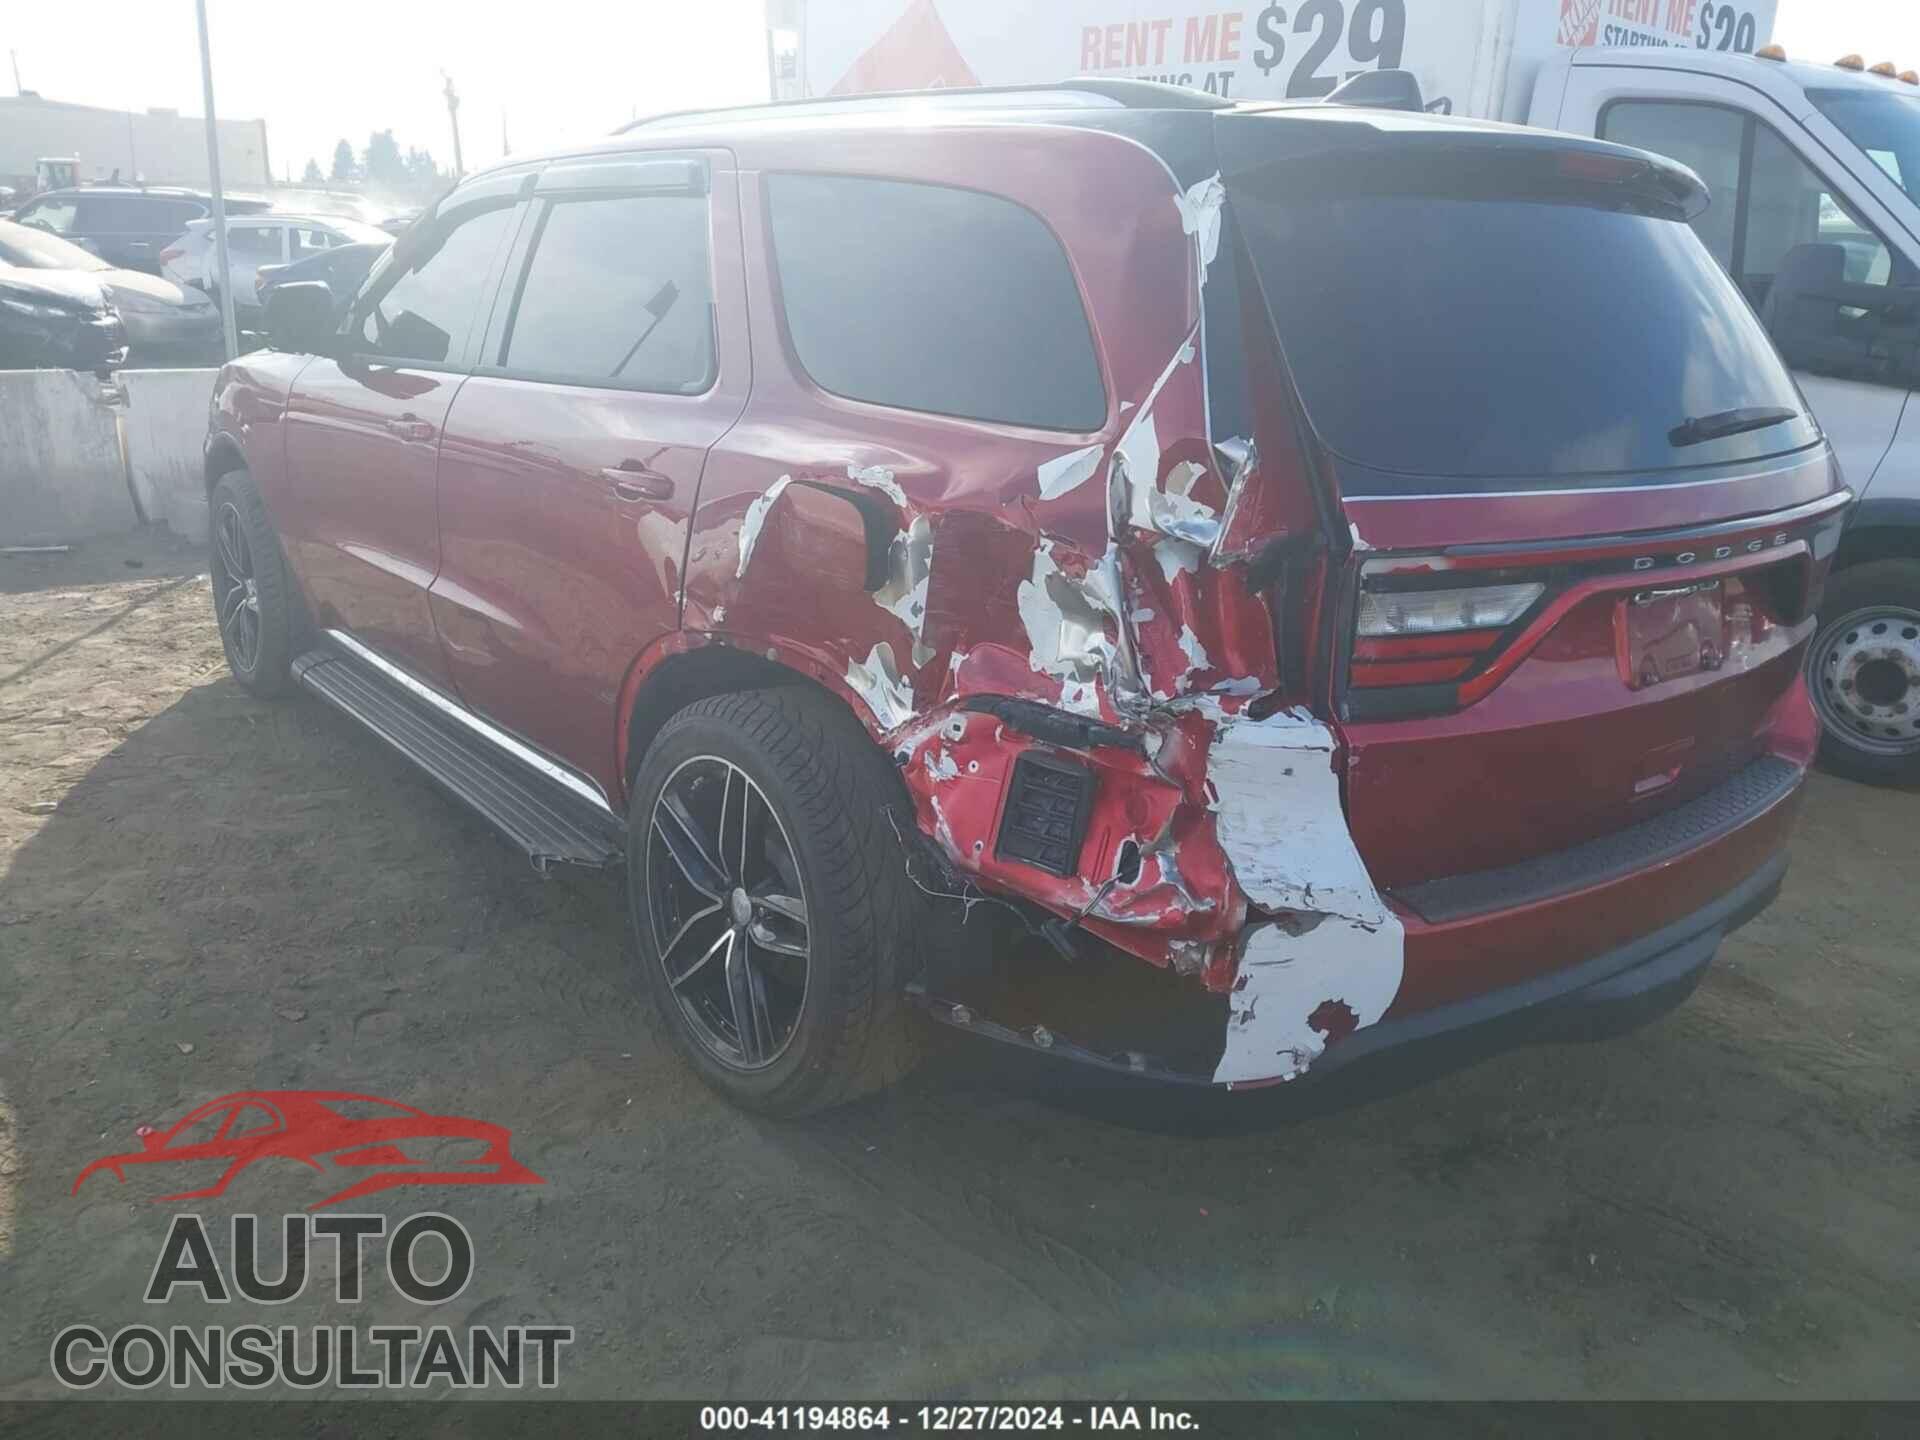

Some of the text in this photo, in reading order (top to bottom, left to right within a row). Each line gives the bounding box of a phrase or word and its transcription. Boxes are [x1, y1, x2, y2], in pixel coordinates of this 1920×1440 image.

[1080, 12, 1243, 71] RENT ME
[1253, 0, 1406, 98] $29
[1203, 71, 1234, 98] AT
[1633, 532, 1788, 570] DODGE
